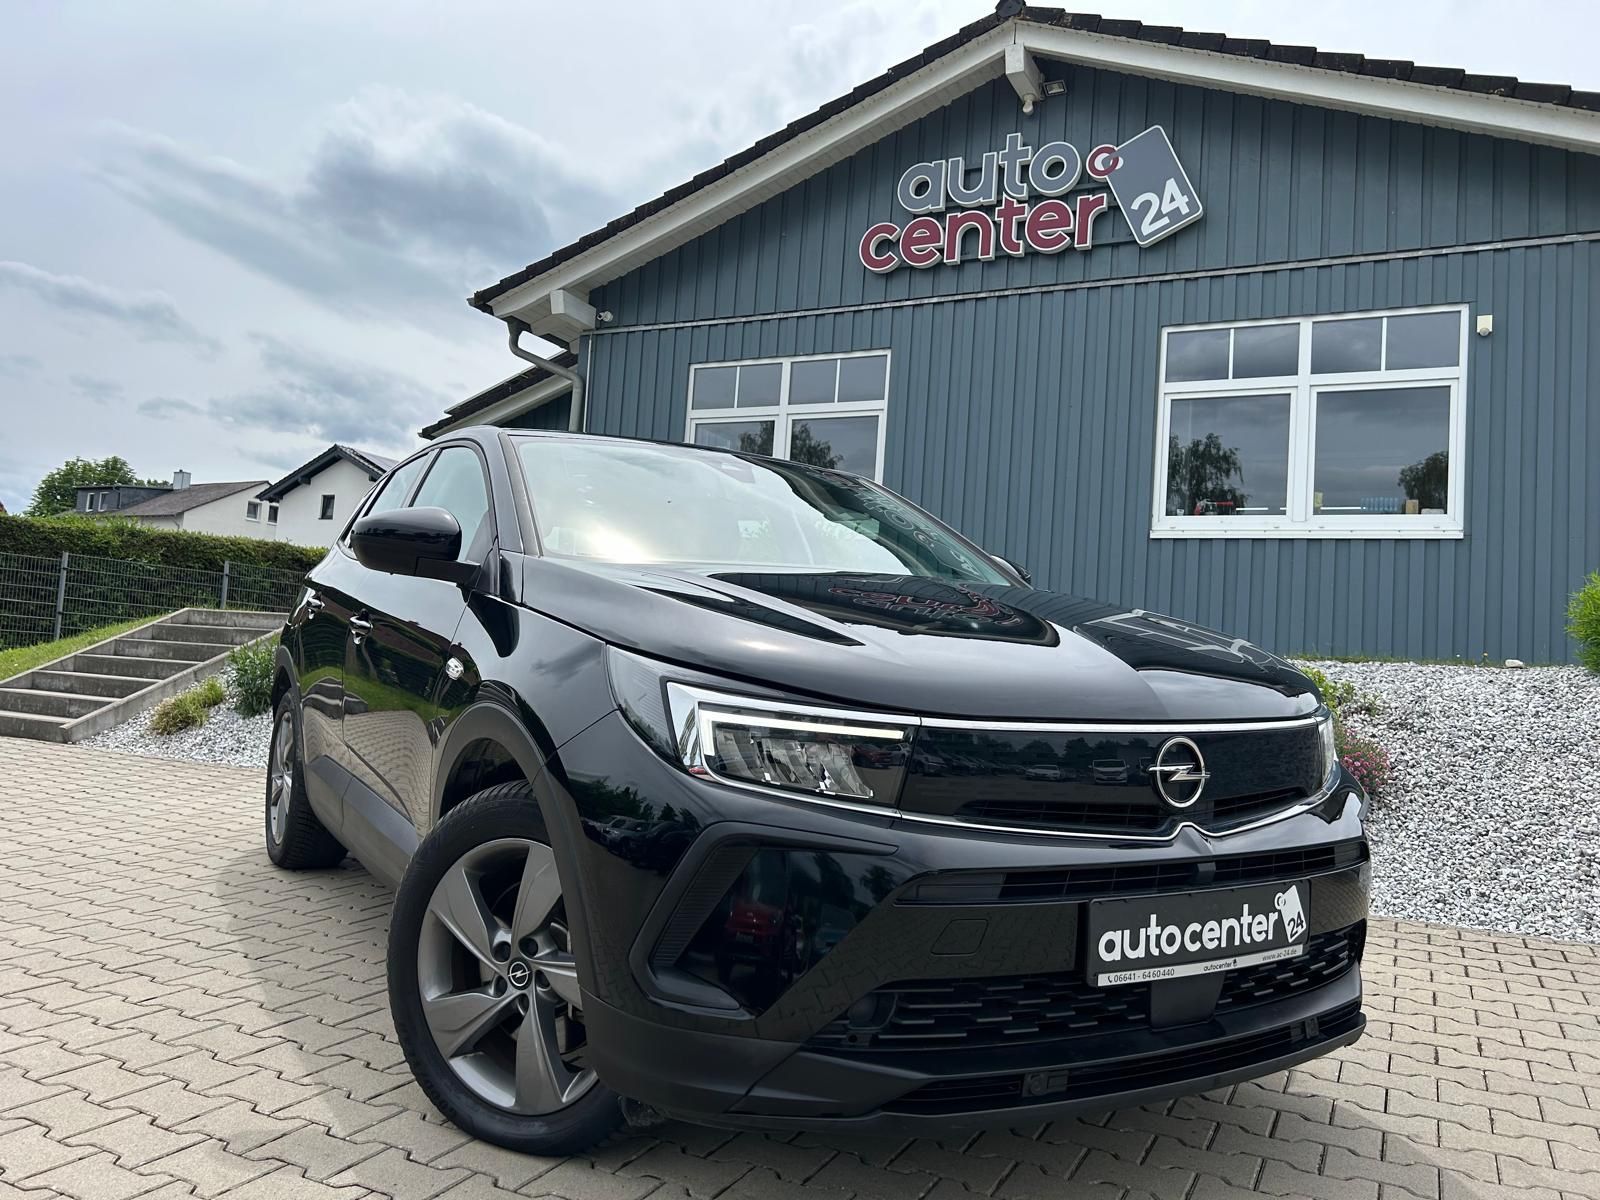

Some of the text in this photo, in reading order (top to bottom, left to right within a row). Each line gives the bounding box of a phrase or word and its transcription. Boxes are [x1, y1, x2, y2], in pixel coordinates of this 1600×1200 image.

[897, 133, 1080, 214] auto
[1130, 178, 1190, 237] 24
[859, 193, 1108, 274] center
[1098, 904, 1279, 961] autocenter
[1287, 911, 1304, 937] 24
[1203, 961, 1232, 971] autocenter
[1262, 948, 1297, 961] www.ac-24.de
[1113, 973, 1136, 983] 06641
